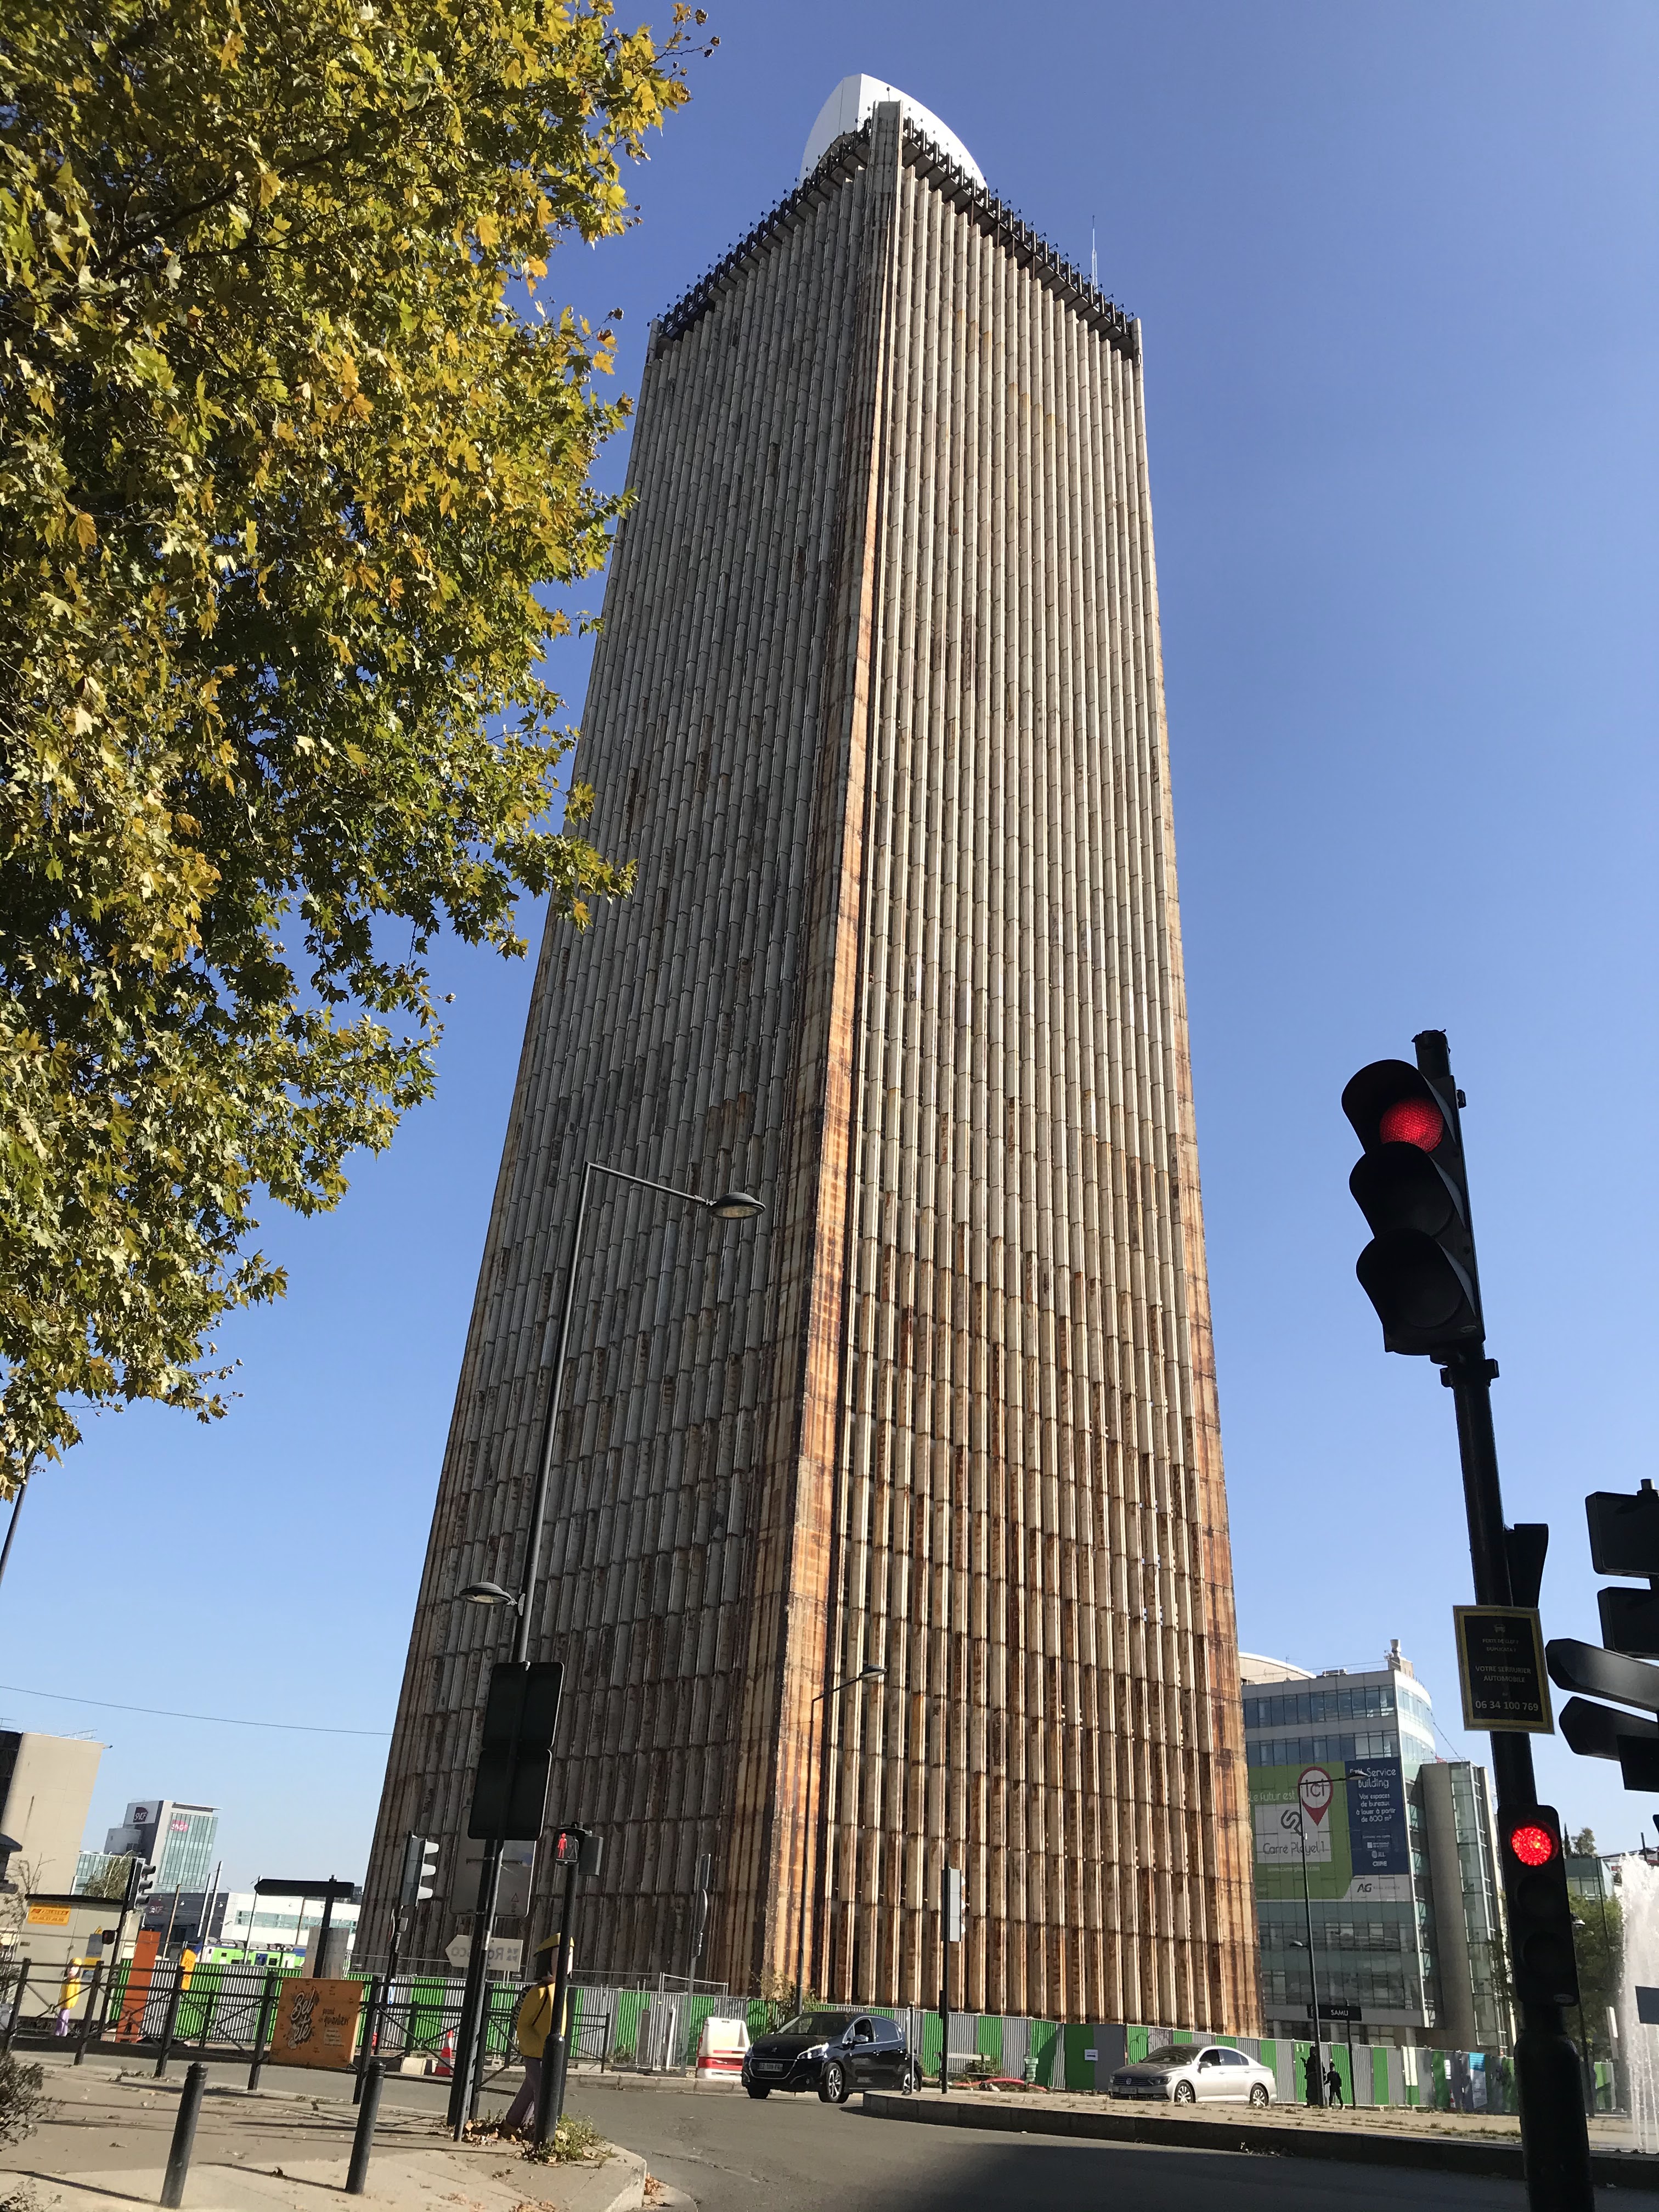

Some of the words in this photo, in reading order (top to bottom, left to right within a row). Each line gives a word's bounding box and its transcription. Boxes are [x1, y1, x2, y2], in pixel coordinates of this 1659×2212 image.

[1475, 1701, 1487, 1709] 06
[1489, 1701, 1502, 1709] 34
[1504, 1701, 1520, 1710] 100
[1522, 1702, 1538, 1711] 769
[1367, 1768, 1396, 1777] Service
[1358, 1778, 1389, 1788] Building
[1250, 1791, 1258, 1802] Le
[1283, 1790, 1295, 1801] est
[134, 1812, 147, 1821] SNCF
[1357, 1883, 1372, 1893] AG
